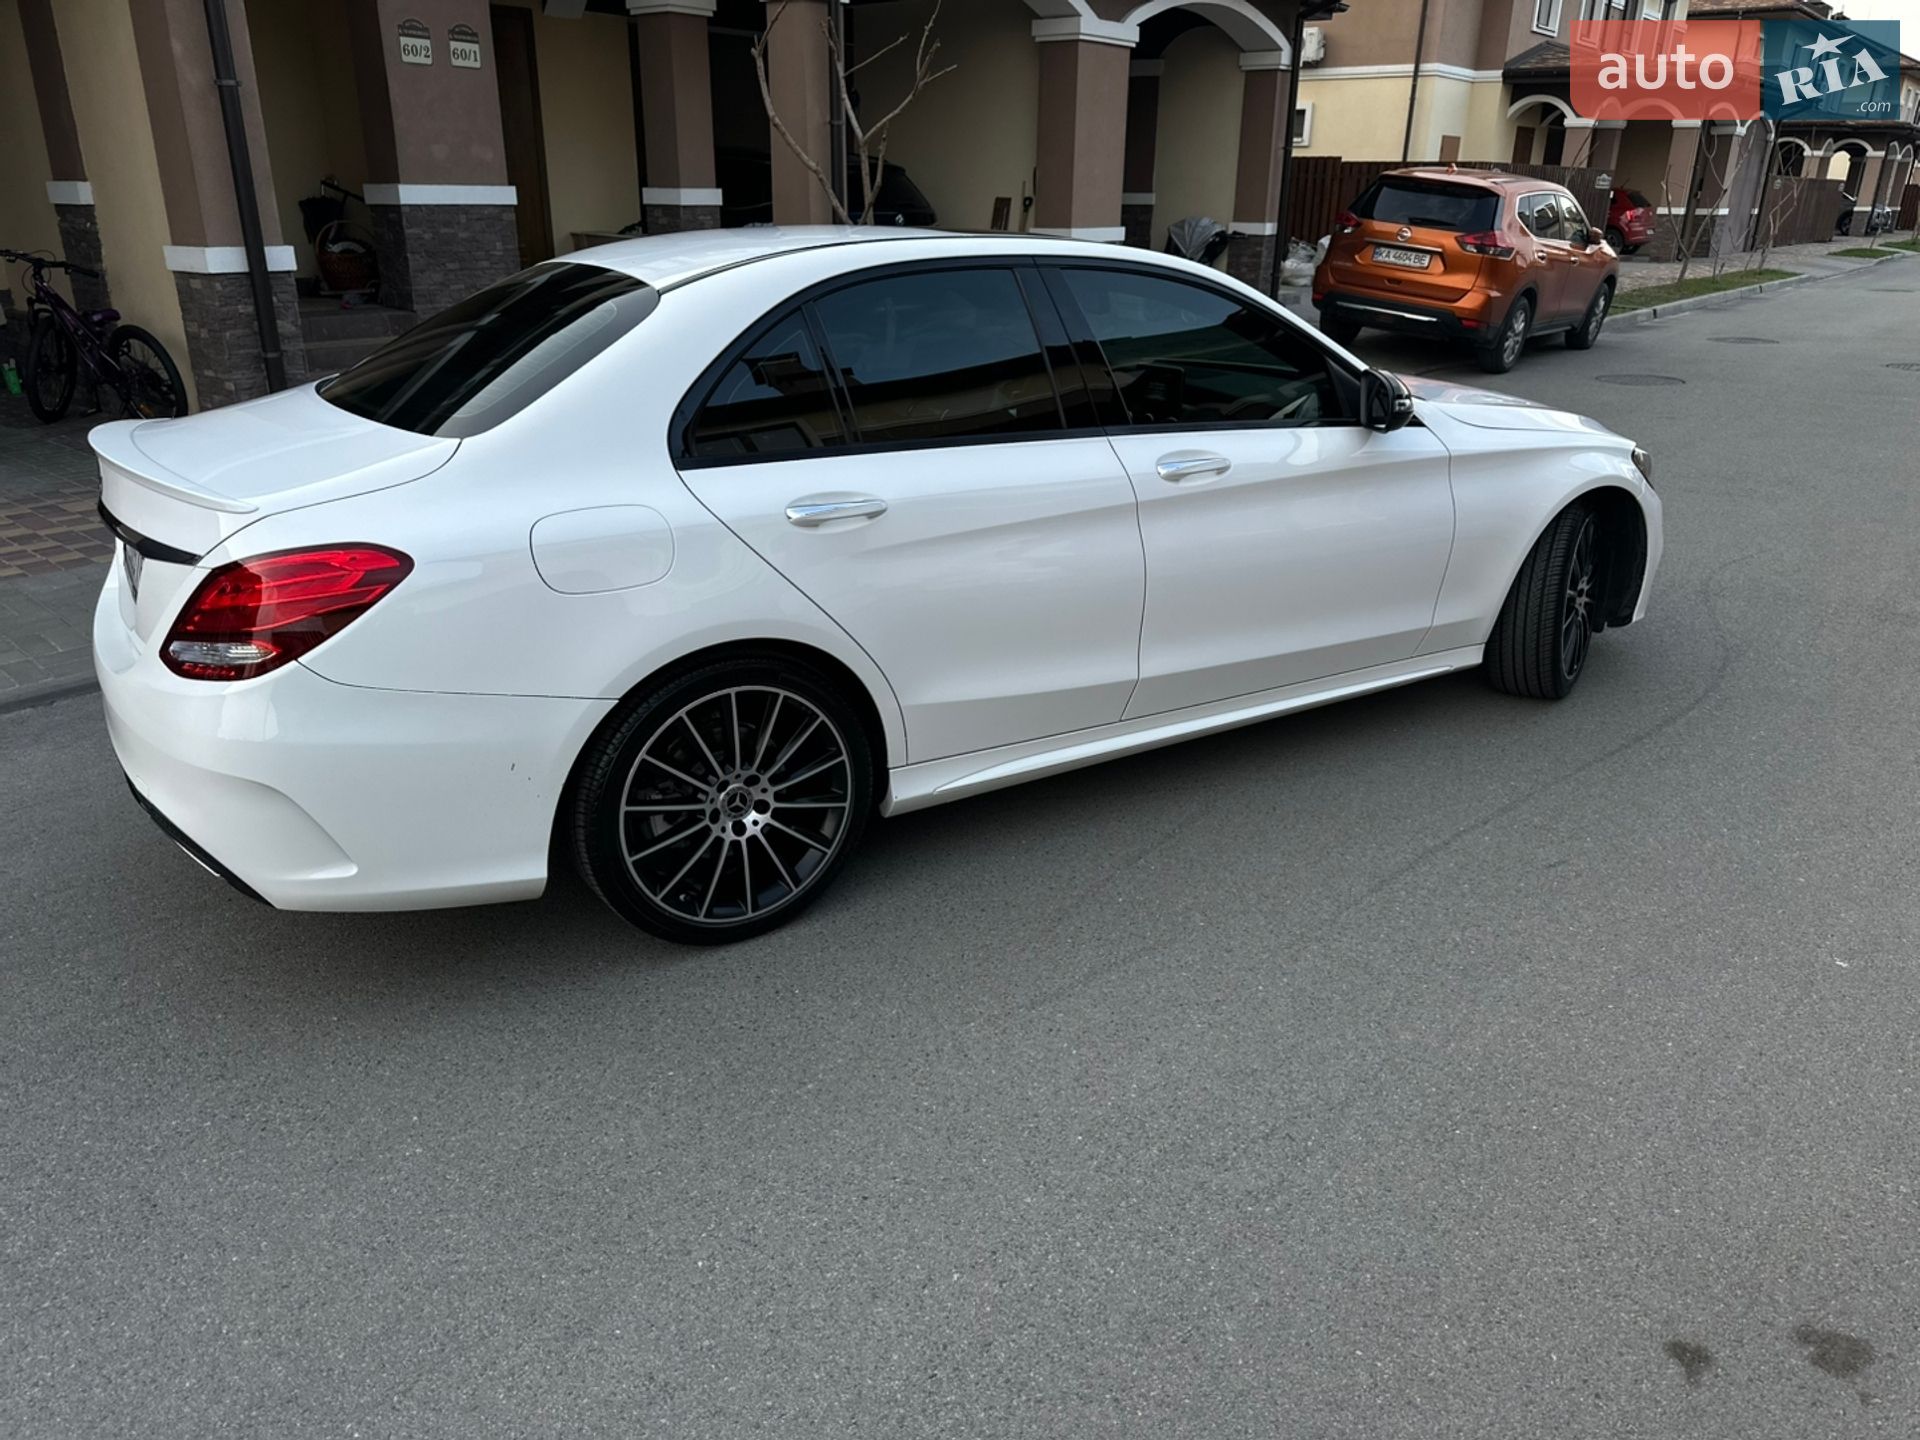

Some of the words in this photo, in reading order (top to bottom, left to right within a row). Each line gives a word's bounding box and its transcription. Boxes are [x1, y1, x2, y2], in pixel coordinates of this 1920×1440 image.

[402, 43, 431, 58] 60/2
[452, 47, 478, 62] 60/1
[1378, 248, 1391, 259] KA
[1392, 251, 1412, 262] 4604
[1413, 254, 1427, 265] BE
